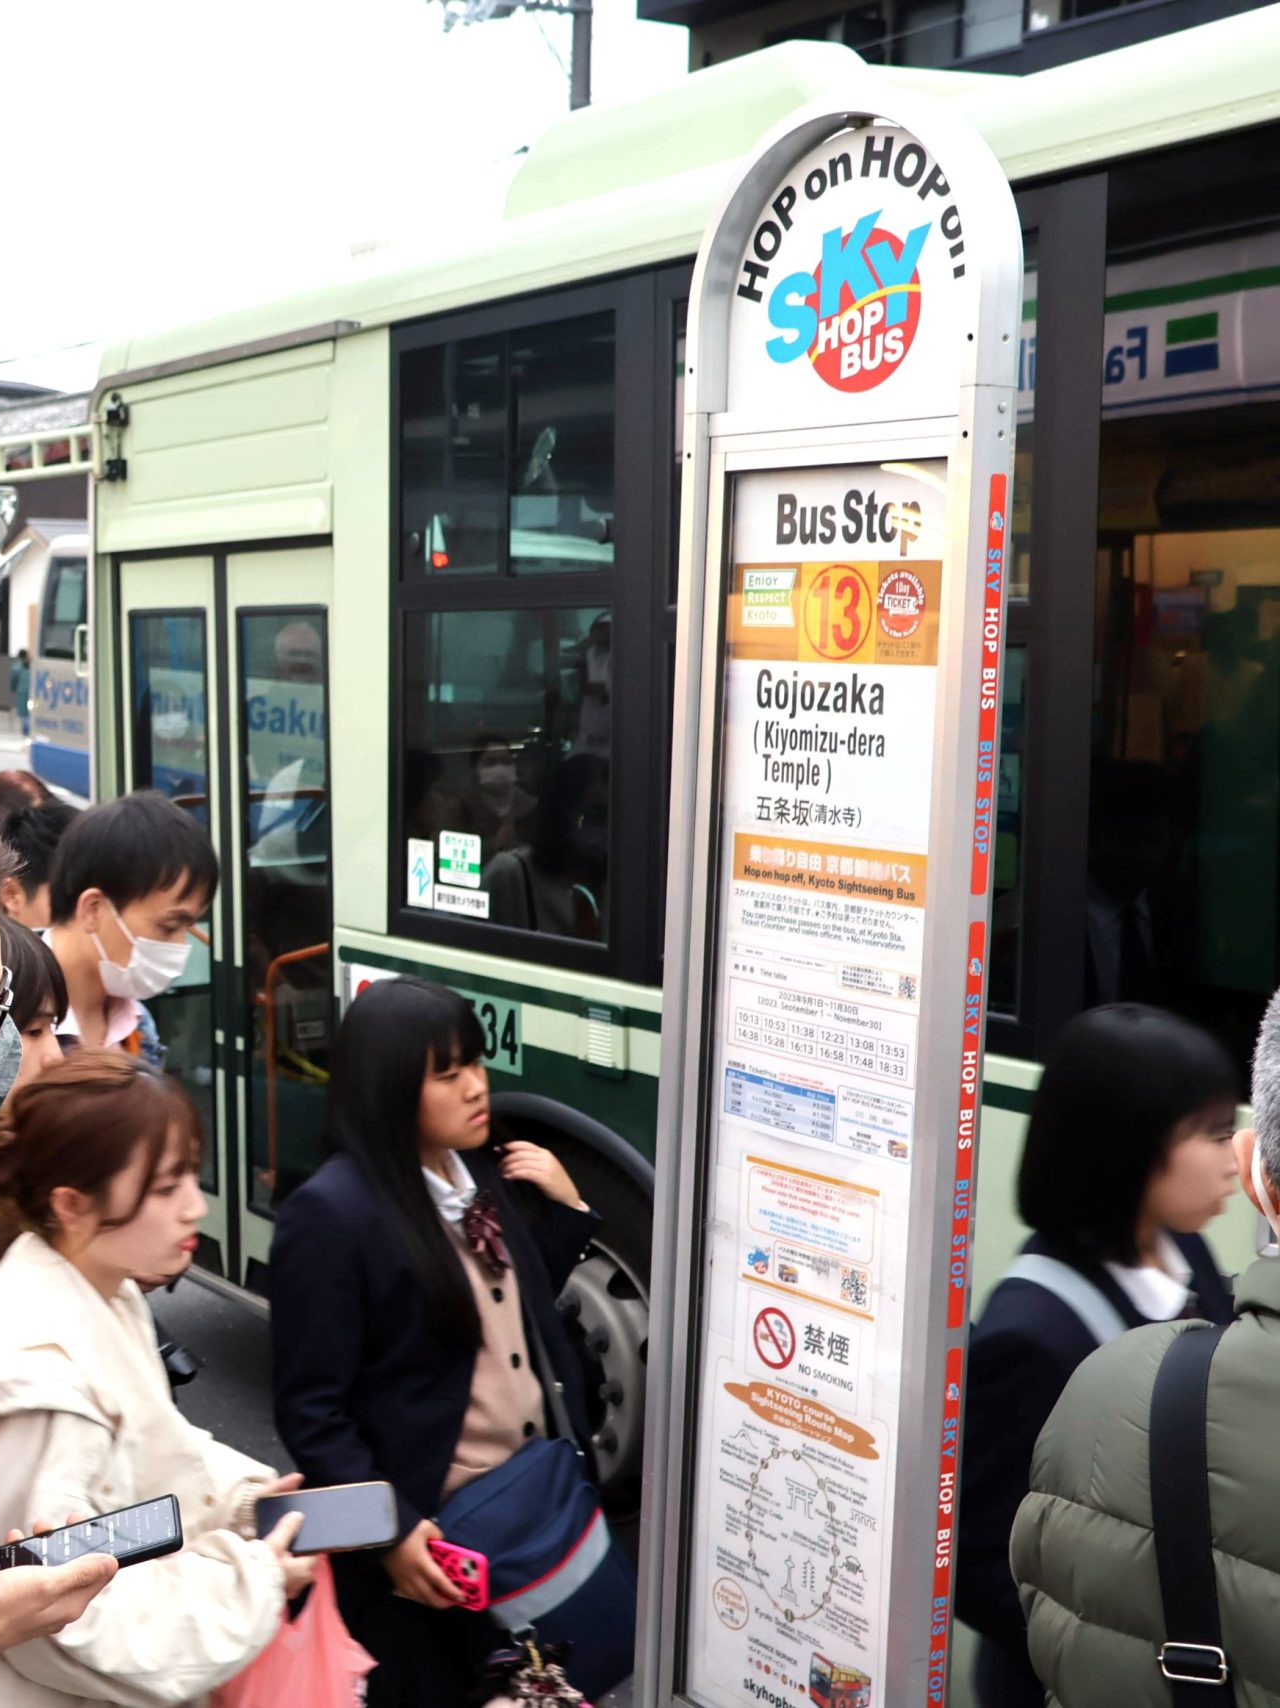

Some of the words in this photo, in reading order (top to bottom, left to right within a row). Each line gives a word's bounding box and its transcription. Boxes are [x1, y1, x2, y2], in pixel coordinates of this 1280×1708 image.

[737, 186, 797, 303] HOP
[804, 152, 853, 200] on
[860, 136, 951, 201] HOP
[766, 208, 933, 364] SKY
[818, 301, 884, 354] HOP
[840, 327, 904, 380] BUS
[776, 493, 836, 545] Bus
[985, 547, 1003, 593] SKY
[813, 575, 862, 651] 13
[982, 607, 1000, 654] HOP
[756, 669, 885, 719] Gojozaka
[980, 667, 997, 710] BUS
[977, 740, 993, 783] BUS
[974, 797, 991, 854] STOP
[744, 865, 761, 879] Hop
[761, 870, 773, 879] on
[774, 869, 790, 883] hop
[808, 875, 835, 889] Kyoto
[838, 879, 894, 900] Sightseeing
[896, 888, 916, 901] Bus
[742, 909, 754, 918] You
[767, 914, 797, 925] purchase
[867, 929, 888, 940] Kyoto
[780, 1000, 818, 1017] September
[964, 993, 981, 1036] SKY
[465, 1000, 518, 1067] 34
[737, 1028, 759, 1041] 14:38
[763, 1034, 785, 1048] 15:28
[790, 1041, 814, 1055] 16:13
[819, 1047, 844, 1062] 16:58
[849, 1054, 874, 1069] 17:48
[879, 1061, 904, 1076] 18:33
[738, 1012, 759, 1025] 10:13
[763, 1018, 786, 1032] 10:53
[791, 1024, 815, 1038] 11:38
[820, 1031, 845, 1045] 12:23
[849, 1037, 874, 1051] 13:08
[880, 1044, 905, 1059] 13:53
[961, 1050, 977, 1095] HOP
[958, 1109, 974, 1151] BUS
[954, 1178, 970, 1221] BUS
[950, 1234, 967, 1290] STOP
[803, 1323, 850, 1366] 禁煙
[798, 1363, 812, 1376] NO
[813, 1369, 854, 1392] SMOKING
[751, 1392, 804, 1423] Sightseeing
[804, 1414, 833, 1434] Route
[834, 1425, 855, 1444] Map
[766, 1387, 801, 1409] KYOTO
[802, 1404, 836, 1424] course
[943, 1417, 957, 1458] SKY
[939, 1472, 955, 1516] HOP
[935, 1528, 951, 1569] BUS
[931, 1596, 948, 1637] BUS
[928, 1650, 945, 1703] STOP
